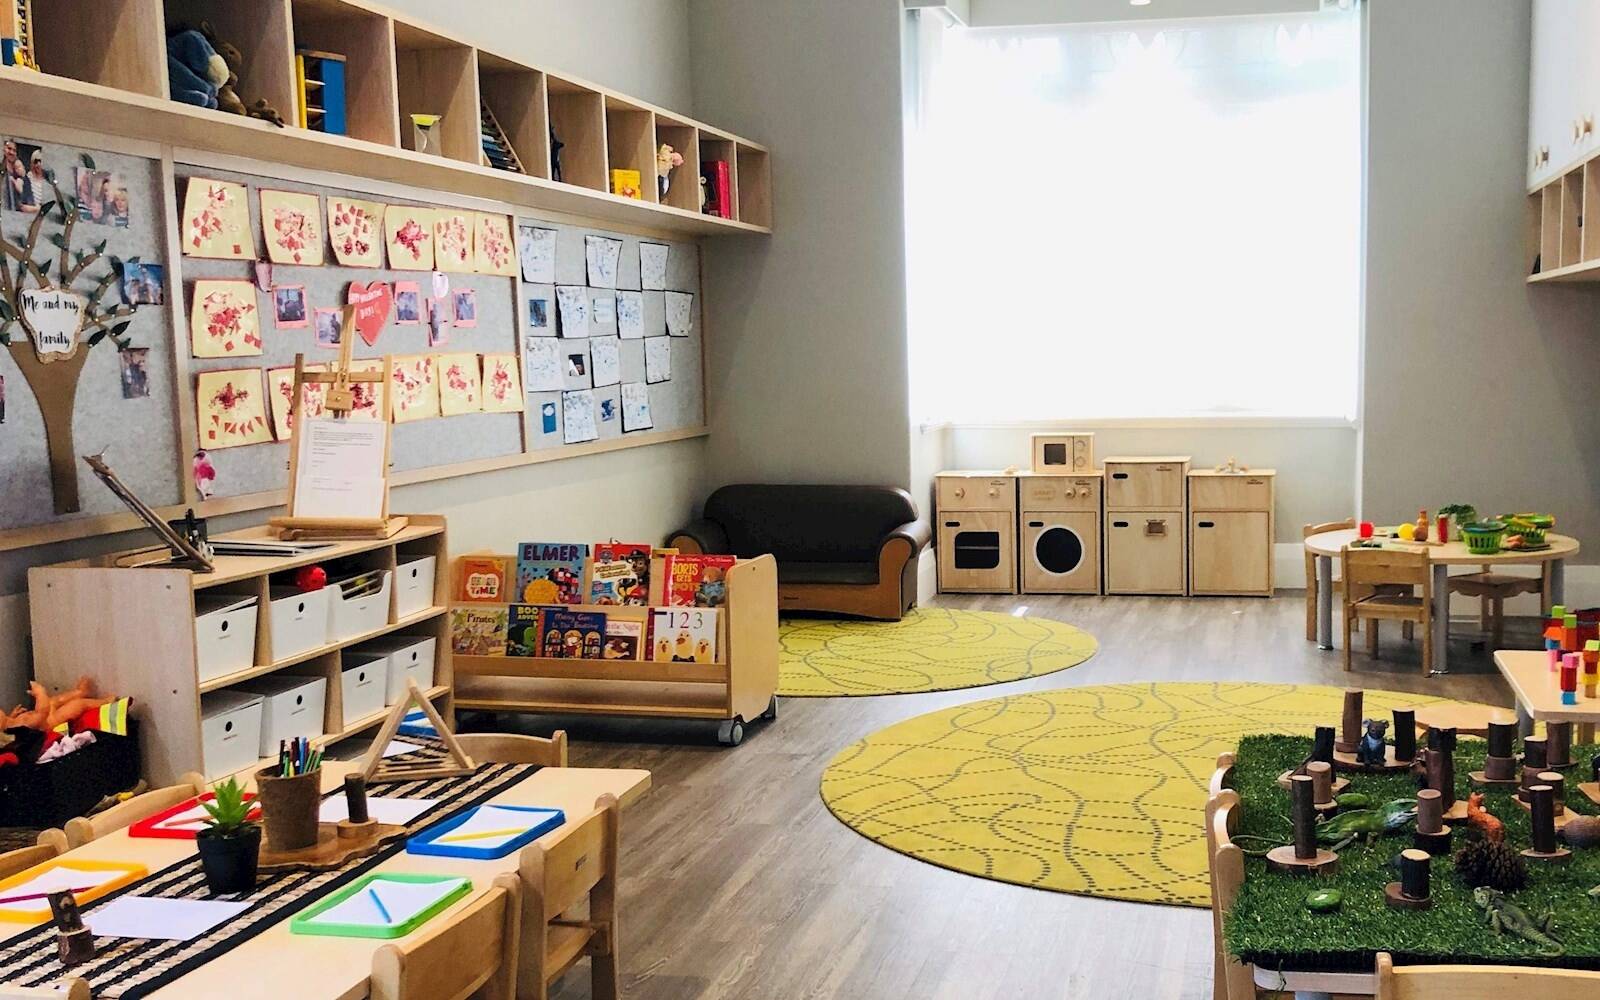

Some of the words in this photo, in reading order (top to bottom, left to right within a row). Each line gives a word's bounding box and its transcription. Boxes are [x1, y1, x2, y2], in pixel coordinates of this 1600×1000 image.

[22, 294, 38, 313] Me
[43, 294, 60, 309] and
[64, 300, 79, 313] my
[39, 331, 70, 350] family
[523, 544, 580, 562] ELMER
[673, 563, 699, 576] BORIS
[466, 612, 497, 623] Pirates
